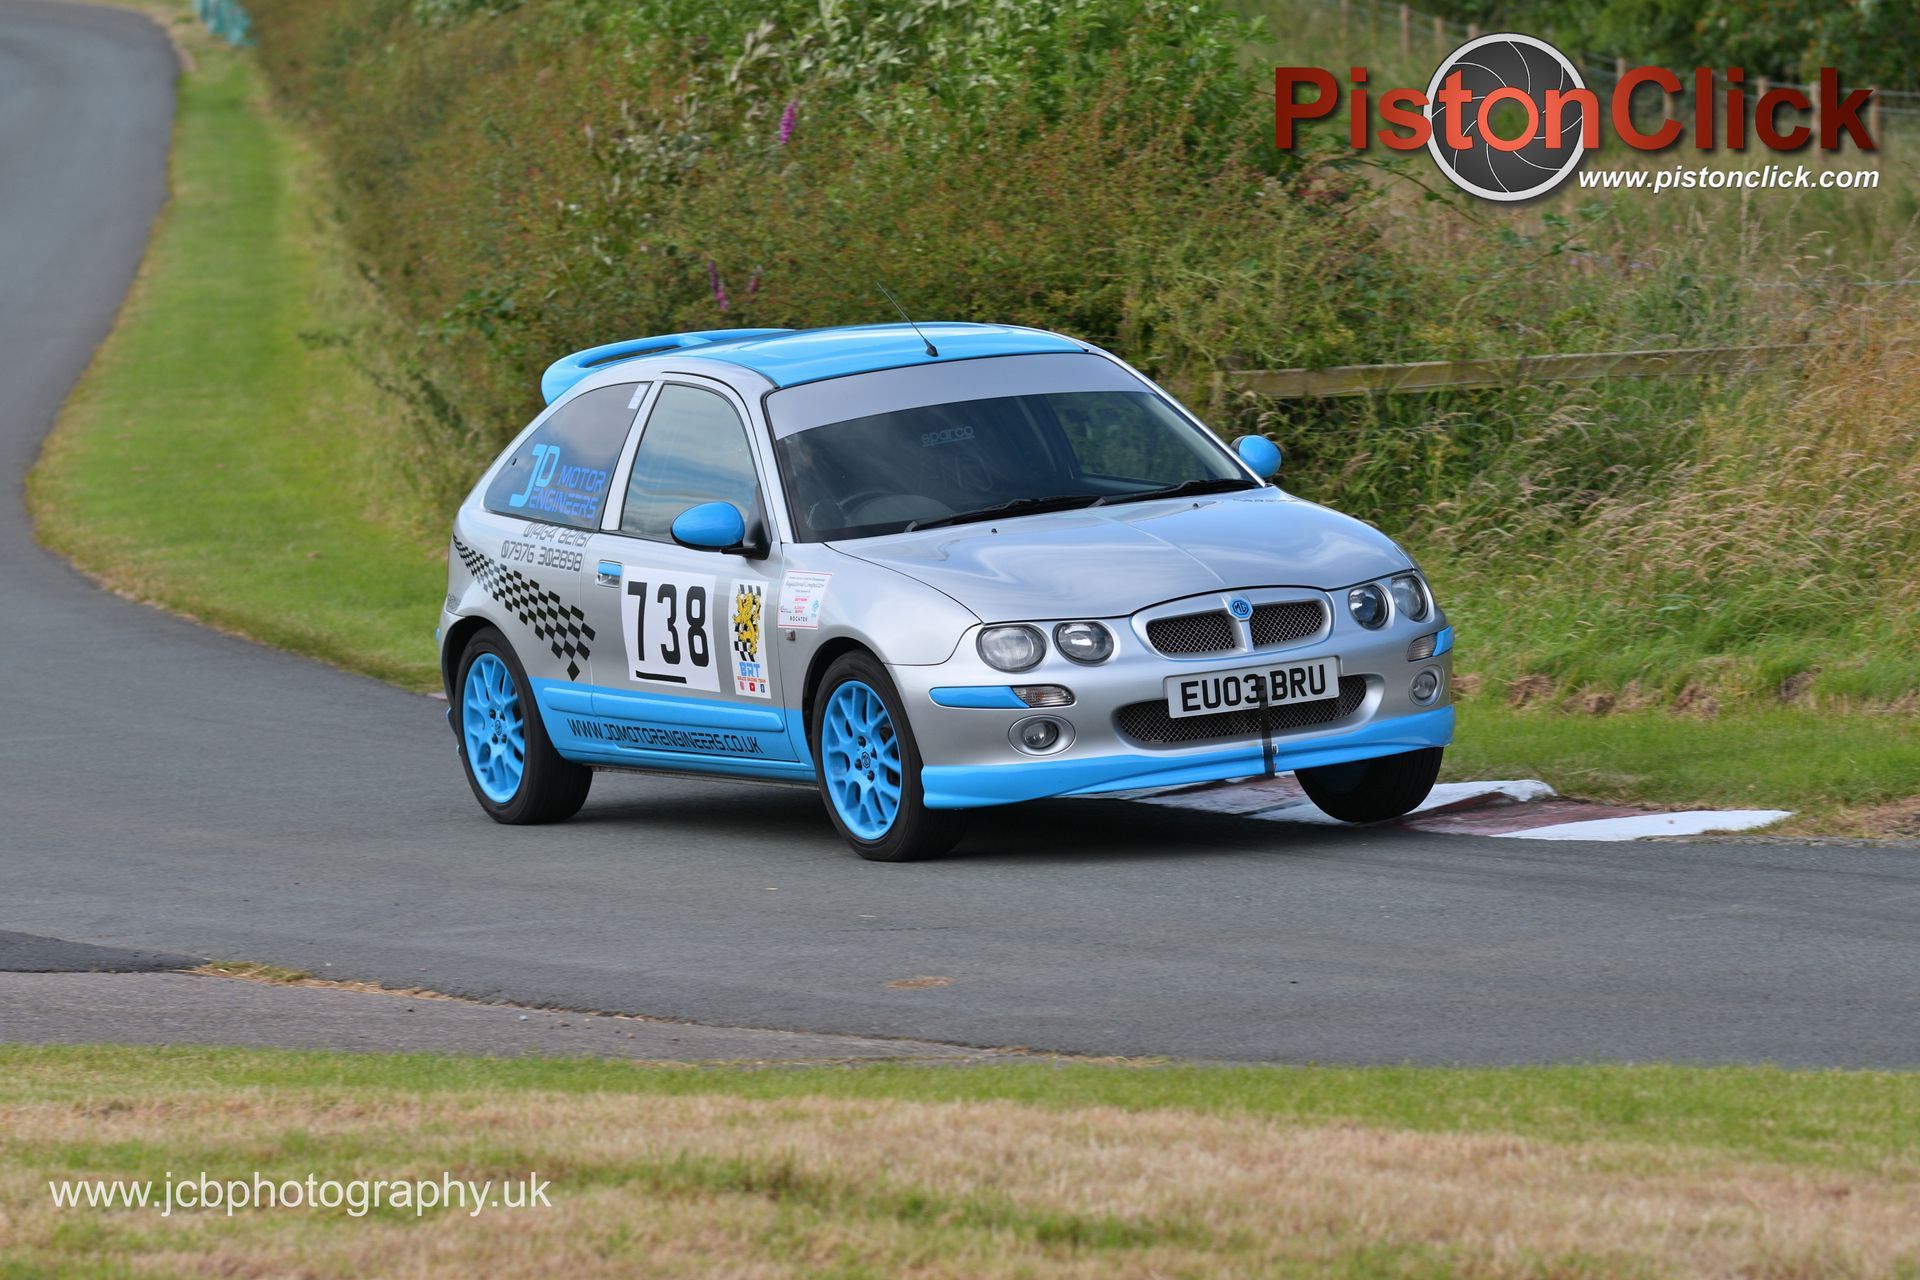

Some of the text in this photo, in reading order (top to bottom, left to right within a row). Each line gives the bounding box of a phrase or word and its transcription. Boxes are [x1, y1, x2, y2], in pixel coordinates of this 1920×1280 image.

[921, 425, 975, 446] sparco
[557, 465, 607, 493] MOTOR
[528, 487, 600, 519] ENGINEERS
[501, 540, 583, 571] 07976 302898
[1233, 603, 1249, 614] MG
[628, 581, 709, 667] 738
[739, 662, 760, 677] BRT
[1181, 664, 1327, 712] EU03 BRU
